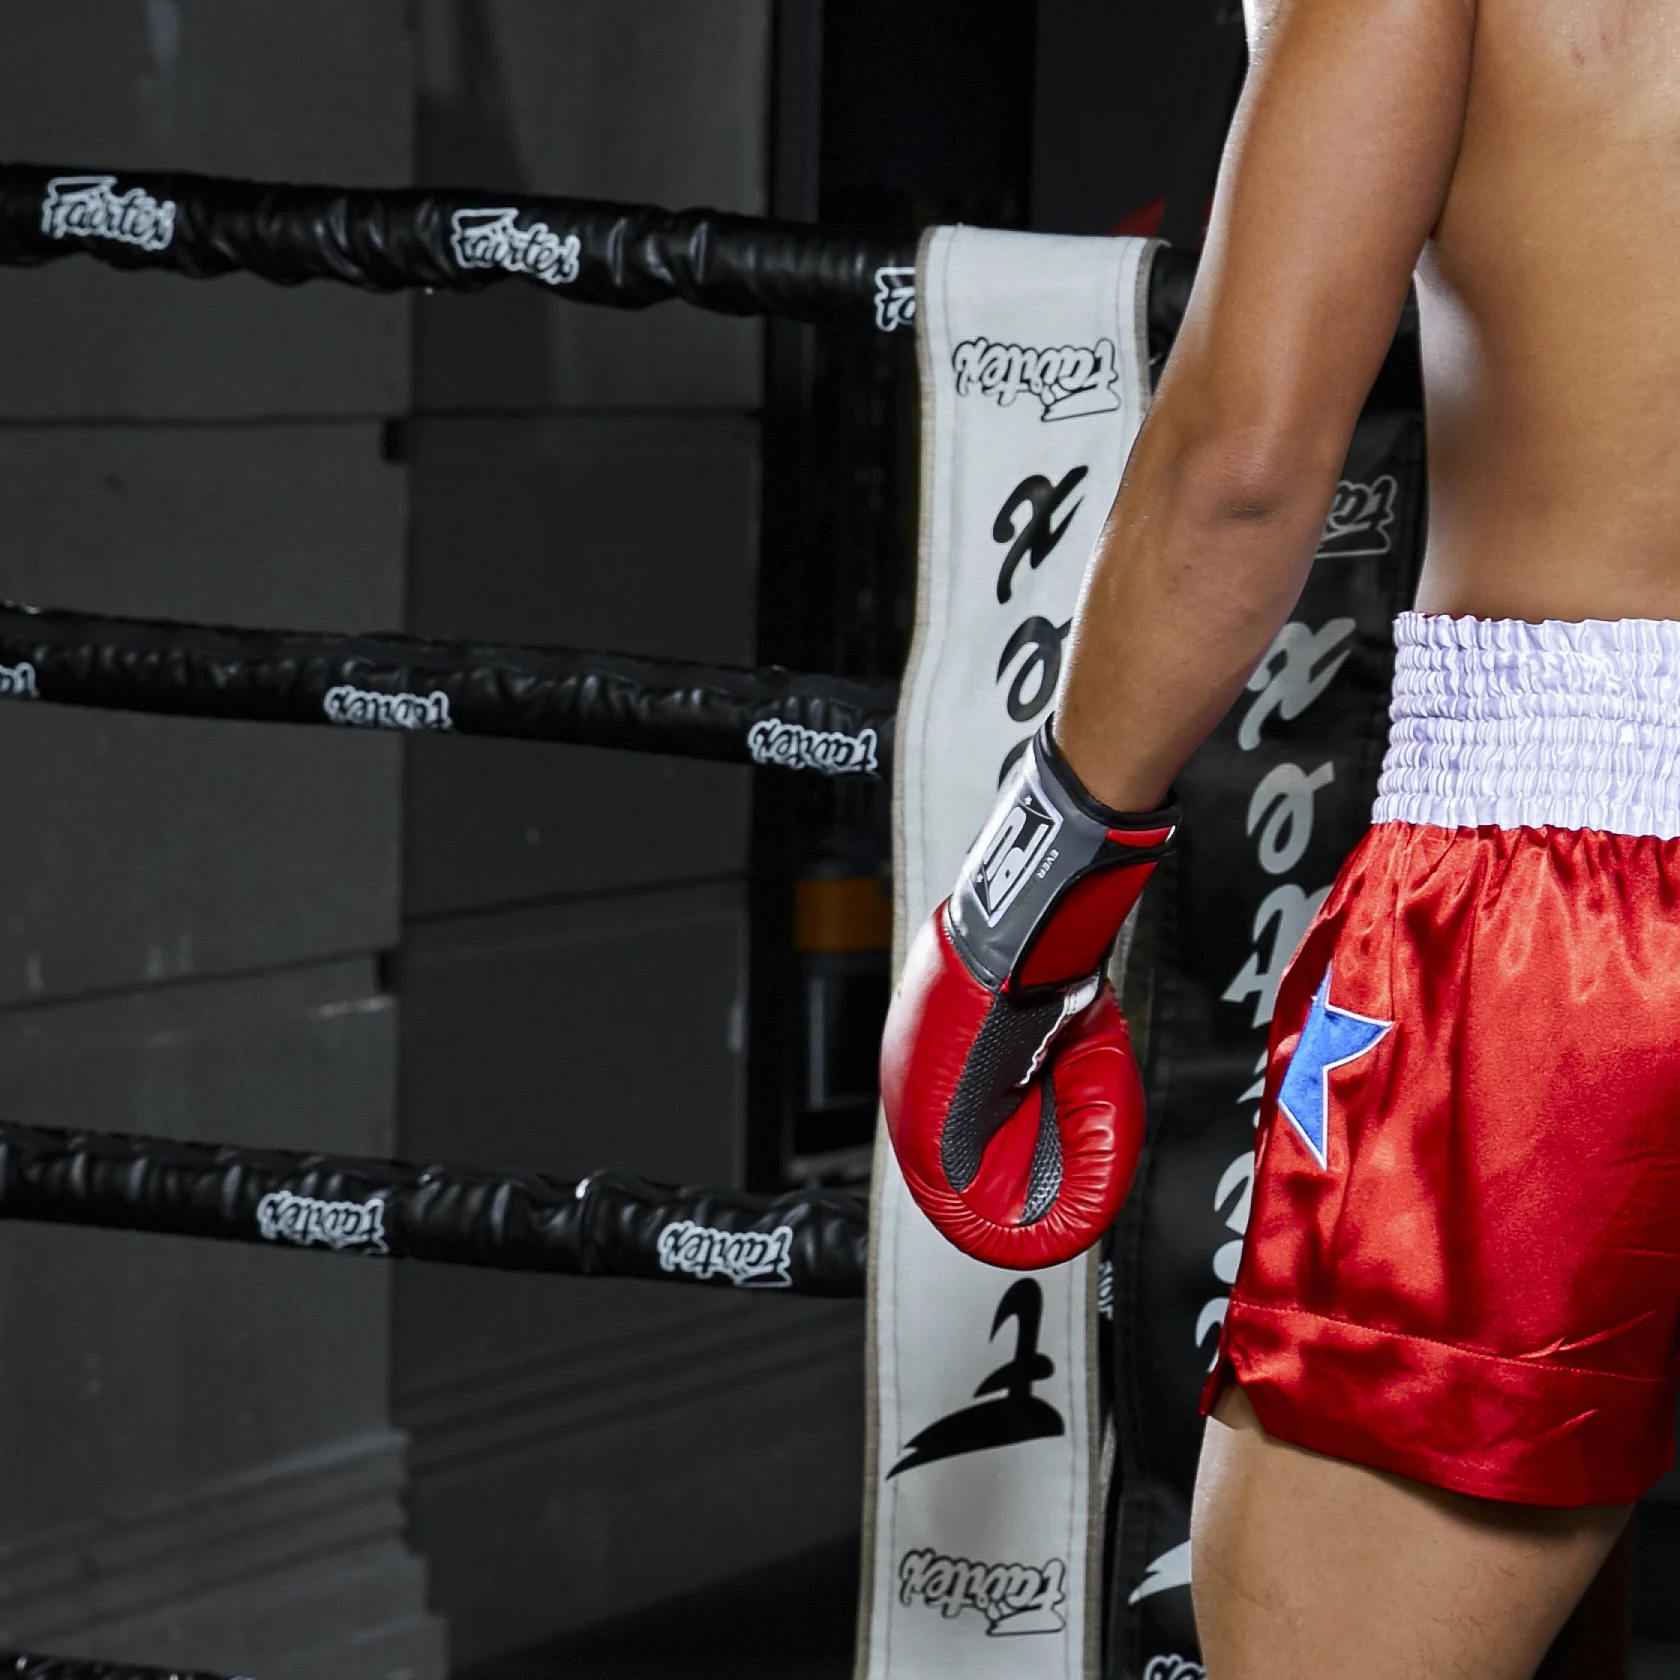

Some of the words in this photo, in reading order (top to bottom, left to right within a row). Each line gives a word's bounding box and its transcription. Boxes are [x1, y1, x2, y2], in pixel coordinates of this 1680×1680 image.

[42, 176, 175, 251] Fairtex
[452, 207, 580, 284] Fairtex
[952, 336, 1122, 423] Fairtex
[1037, 848, 1061, 879] EVER
[656, 1220, 794, 1288] Fairtex
[901, 1546, 1067, 1637] Fairtex
